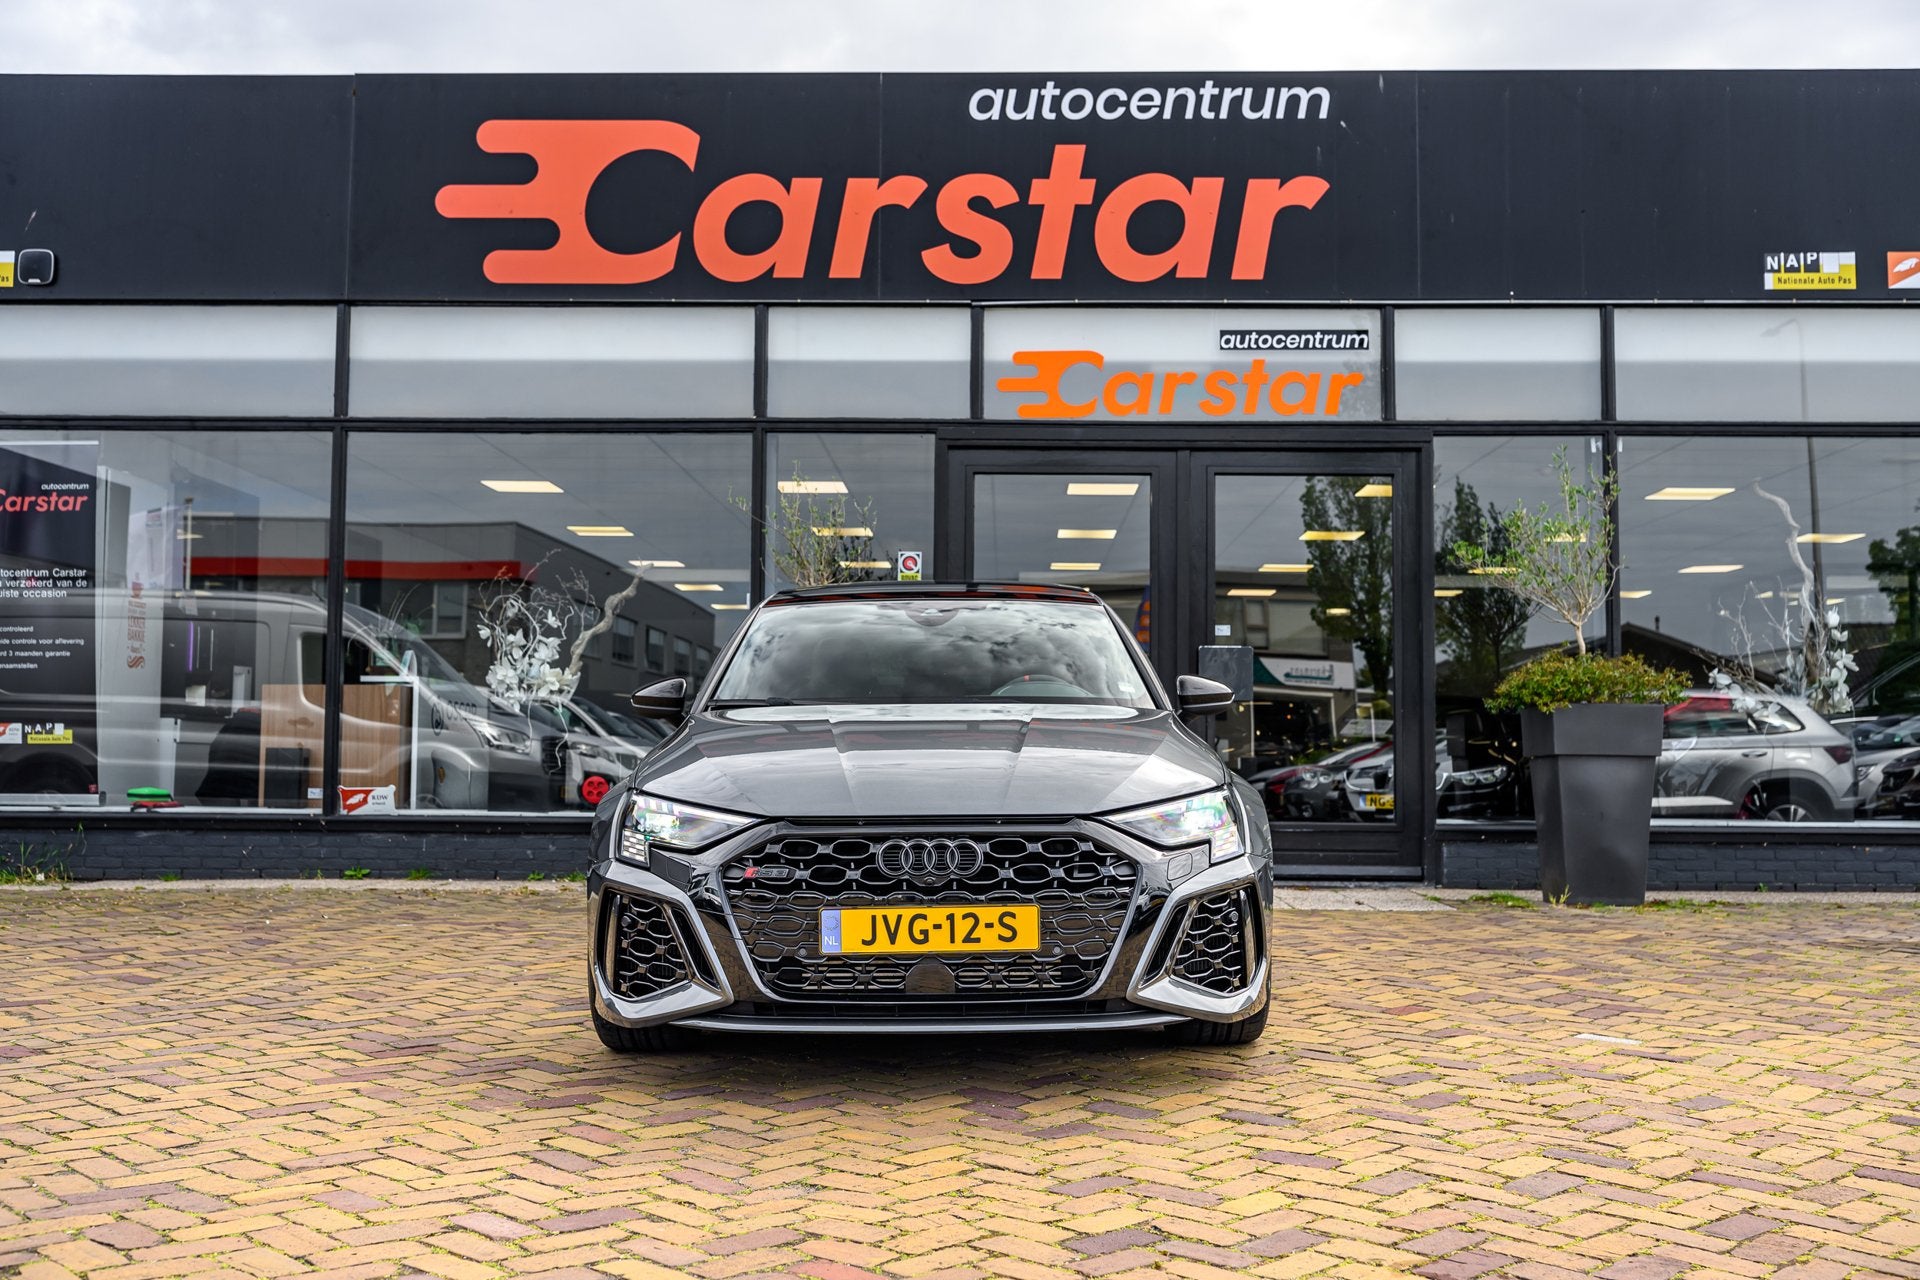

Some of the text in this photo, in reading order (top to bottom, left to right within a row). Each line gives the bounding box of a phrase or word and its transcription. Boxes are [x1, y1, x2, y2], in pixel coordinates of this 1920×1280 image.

[968, 80, 1331, 121] autocentrum
[435, 119, 1331, 285] Carstar
[1766, 252, 1818, 271] NAP
[1777, 277, 1852, 285] Nationale Auto Pas
[1220, 331, 1369, 349] autocentrum
[996, 350, 1364, 418] Carstar
[52, 568, 87, 577] Carstar
[6, 578, 88, 588] verzekerd van de
[22, 589, 67, 598] occasion
[55, 638, 85, 646] aflevering
[24, 722, 53, 734] NAP
[861, 911, 1018, 946] JVG-12-S
[824, 936, 839, 946] NL
